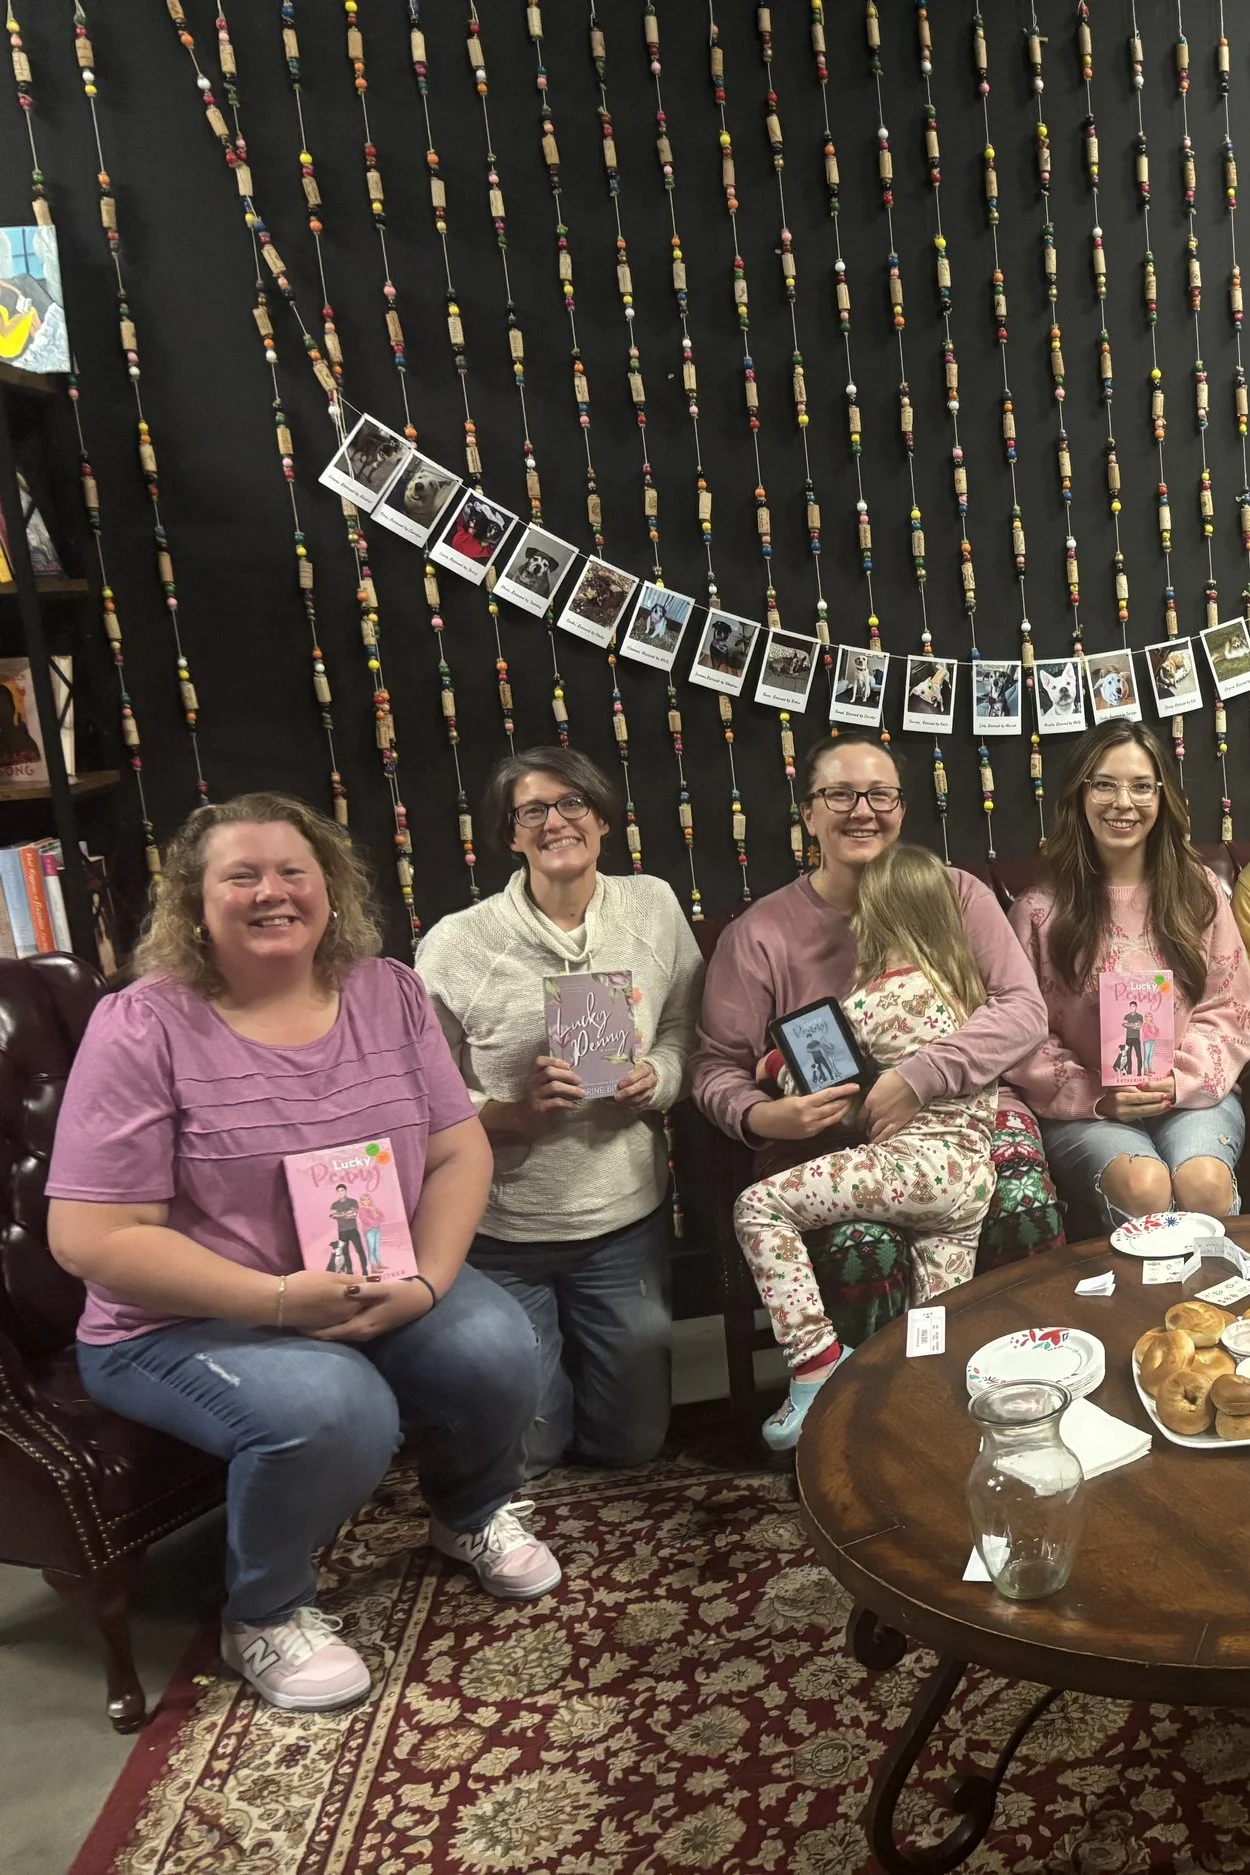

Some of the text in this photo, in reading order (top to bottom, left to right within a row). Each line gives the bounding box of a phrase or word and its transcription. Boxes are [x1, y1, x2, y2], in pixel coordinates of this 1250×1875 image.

[1114, 982, 1162, 1012] Penny
[1131, 982, 1158, 991] Lucky
[558, 992, 611, 1038] Lucky
[571, 1030, 628, 1066] Penny
[310, 1163, 380, 1192] Penny
[332, 1157, 372, 1171] Lucky
